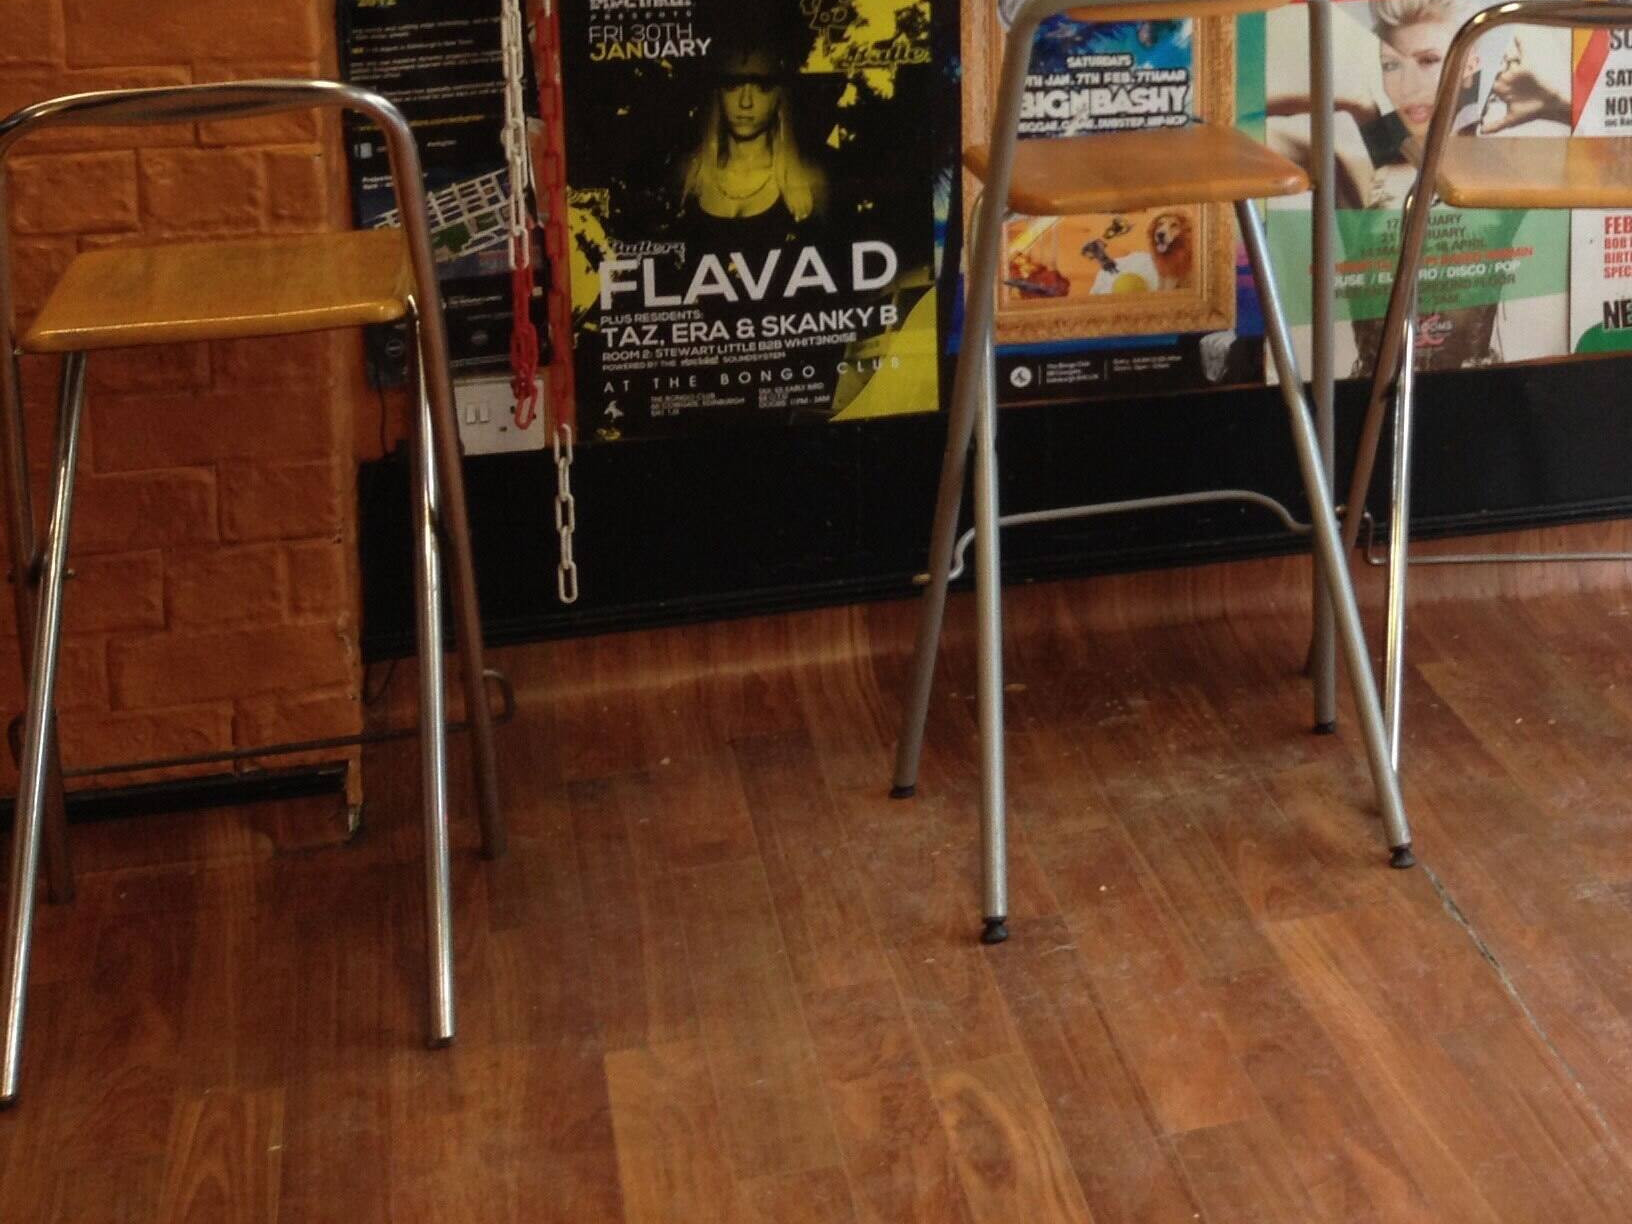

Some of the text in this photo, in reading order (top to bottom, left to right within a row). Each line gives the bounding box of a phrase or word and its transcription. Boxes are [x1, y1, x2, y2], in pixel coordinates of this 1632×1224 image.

[588, 21, 694, 45] FRI 30TH
[589, 36, 713, 63] JANUARY
[1066, 54, 1131, 69] SATURDAYS
[1604, 237, 1627, 249] BOB
[600, 244, 838, 311] FLAVA
[851, 240, 899, 292] D
[1447, 263, 1486, 278] DISCO
[1494, 260, 1521, 273] POP
[600, 312, 632, 326] PLUS
[672, 319, 730, 345] ERA
[736, 317, 756, 339] &
[761, 306, 874, 337] SKANKY
[880, 303, 898, 326] B
[602, 350, 641, 364] ROOM
[655, 344, 715, 359] STEWART
[717, 340, 756, 356] LITTLE
[758, 338, 782, 352] B2B
[604, 356, 901, 394] AT THE BONGO CLUB
